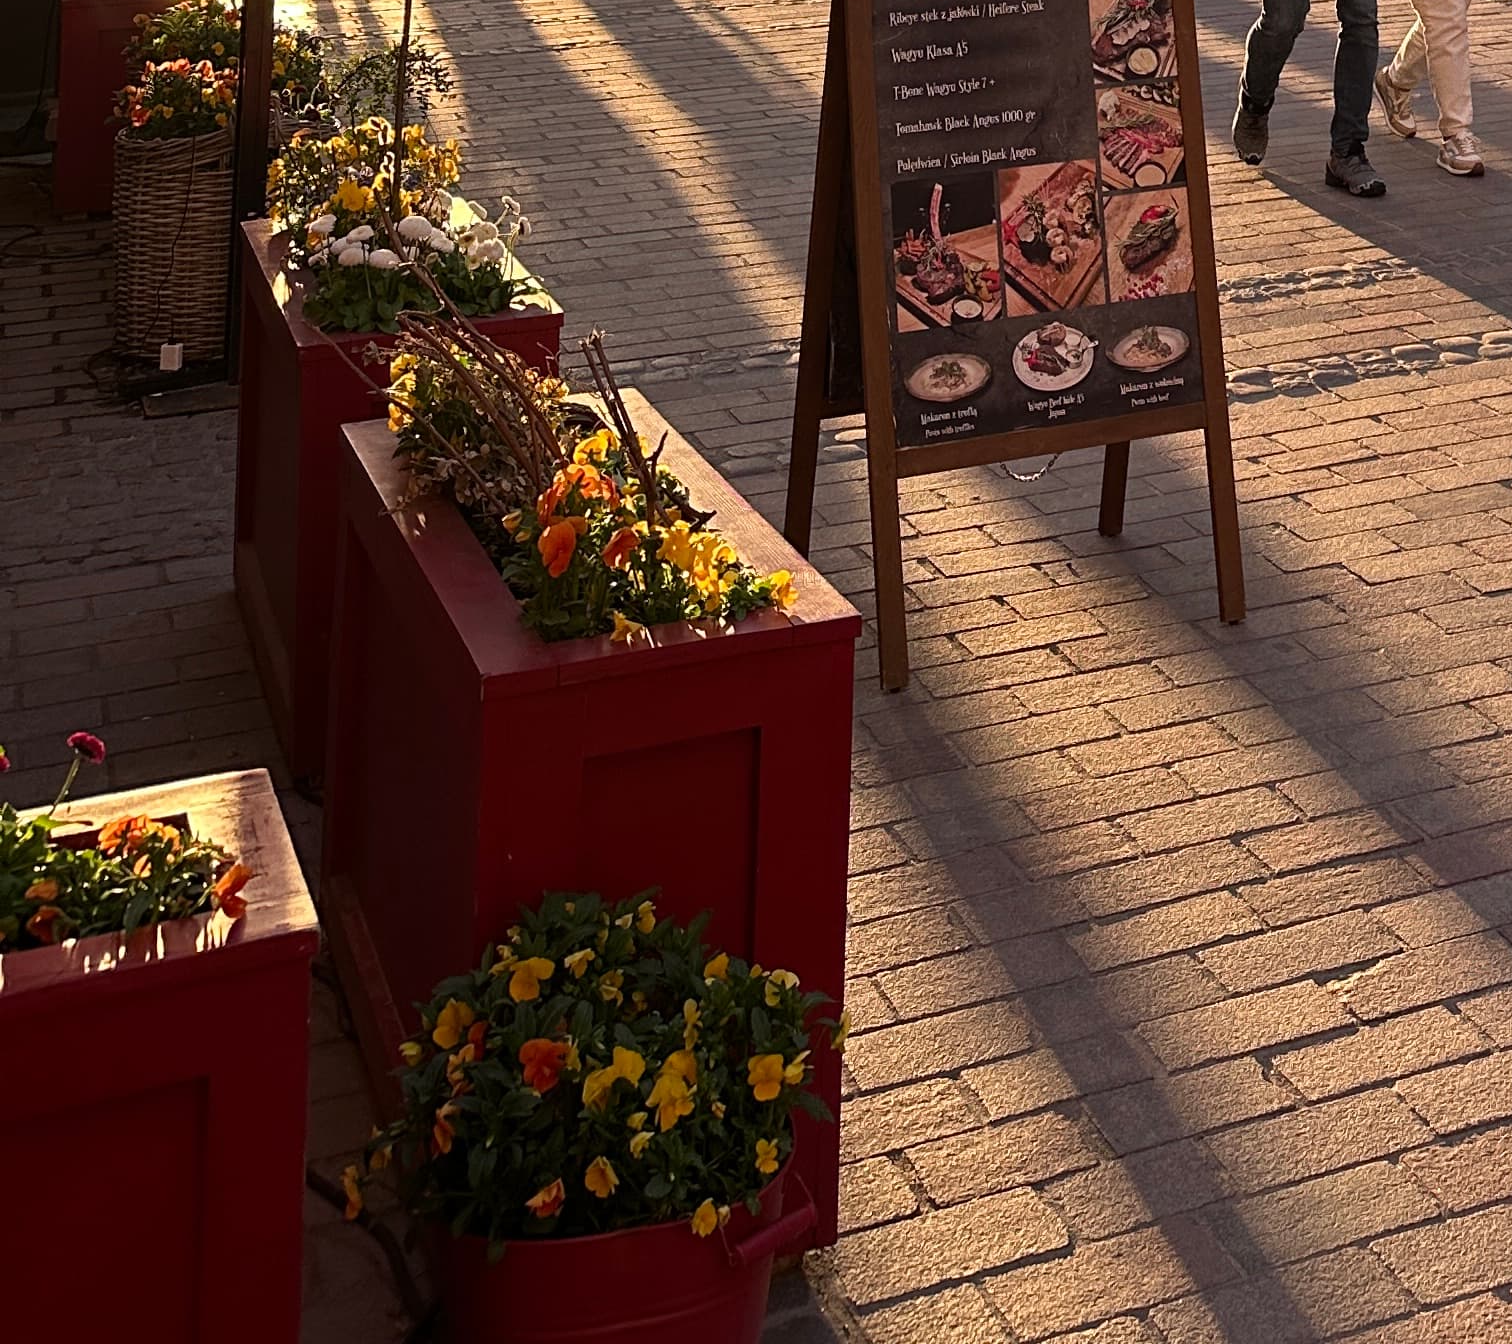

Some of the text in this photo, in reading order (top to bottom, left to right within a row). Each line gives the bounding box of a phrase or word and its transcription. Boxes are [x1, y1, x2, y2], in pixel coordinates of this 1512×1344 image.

[891, 39, 969, 64] Wagyu Klasa A5
[893, 84, 925, 101] T-Bone
[926, 81, 956, 97] Wagyu
[958, 77, 980, 94] Style
[944, 113, 970, 132] Black
[972, 113, 1000, 128] Angus
[1001, 109, 1023, 123] 1000
[1025, 110, 1036, 124] gr
[982, 147, 1008, 164] Black
[1009, 145, 1037, 161] Angus
